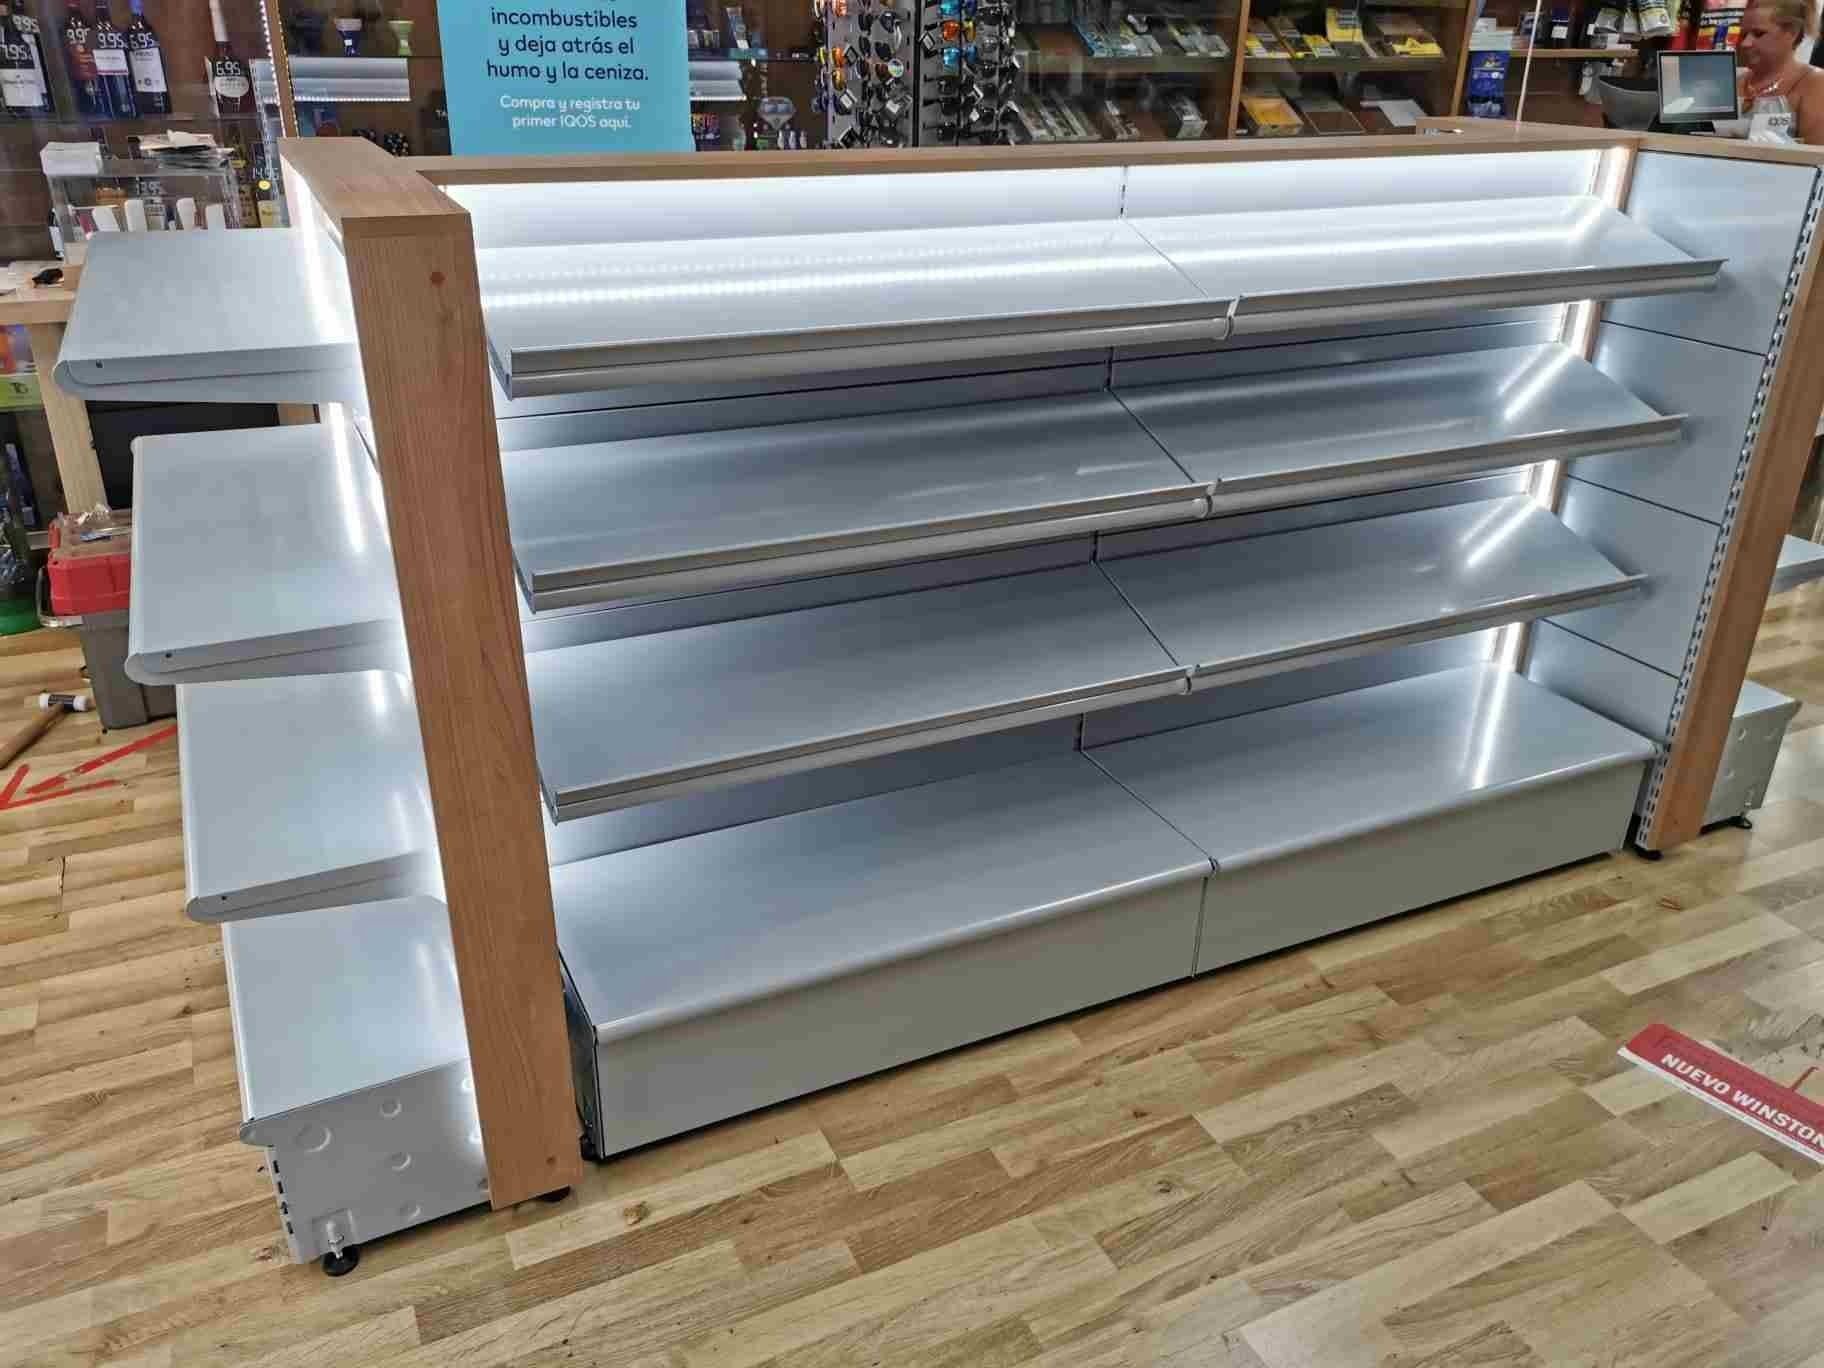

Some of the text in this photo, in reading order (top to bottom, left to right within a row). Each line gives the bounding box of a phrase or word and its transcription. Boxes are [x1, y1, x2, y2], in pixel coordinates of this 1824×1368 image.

[491, 7, 638, 28] incombustibles
[498, 34, 635, 57] y deja atrás el
[486, 60, 649, 84] humo y la ceniza.
[500, 95, 641, 113] Compra y registra tu
[512, 114, 557, 129] primer
[560, 114, 597, 128] IQOS
[1661, 1053, 1824, 1148] NUEVO WINSTON
